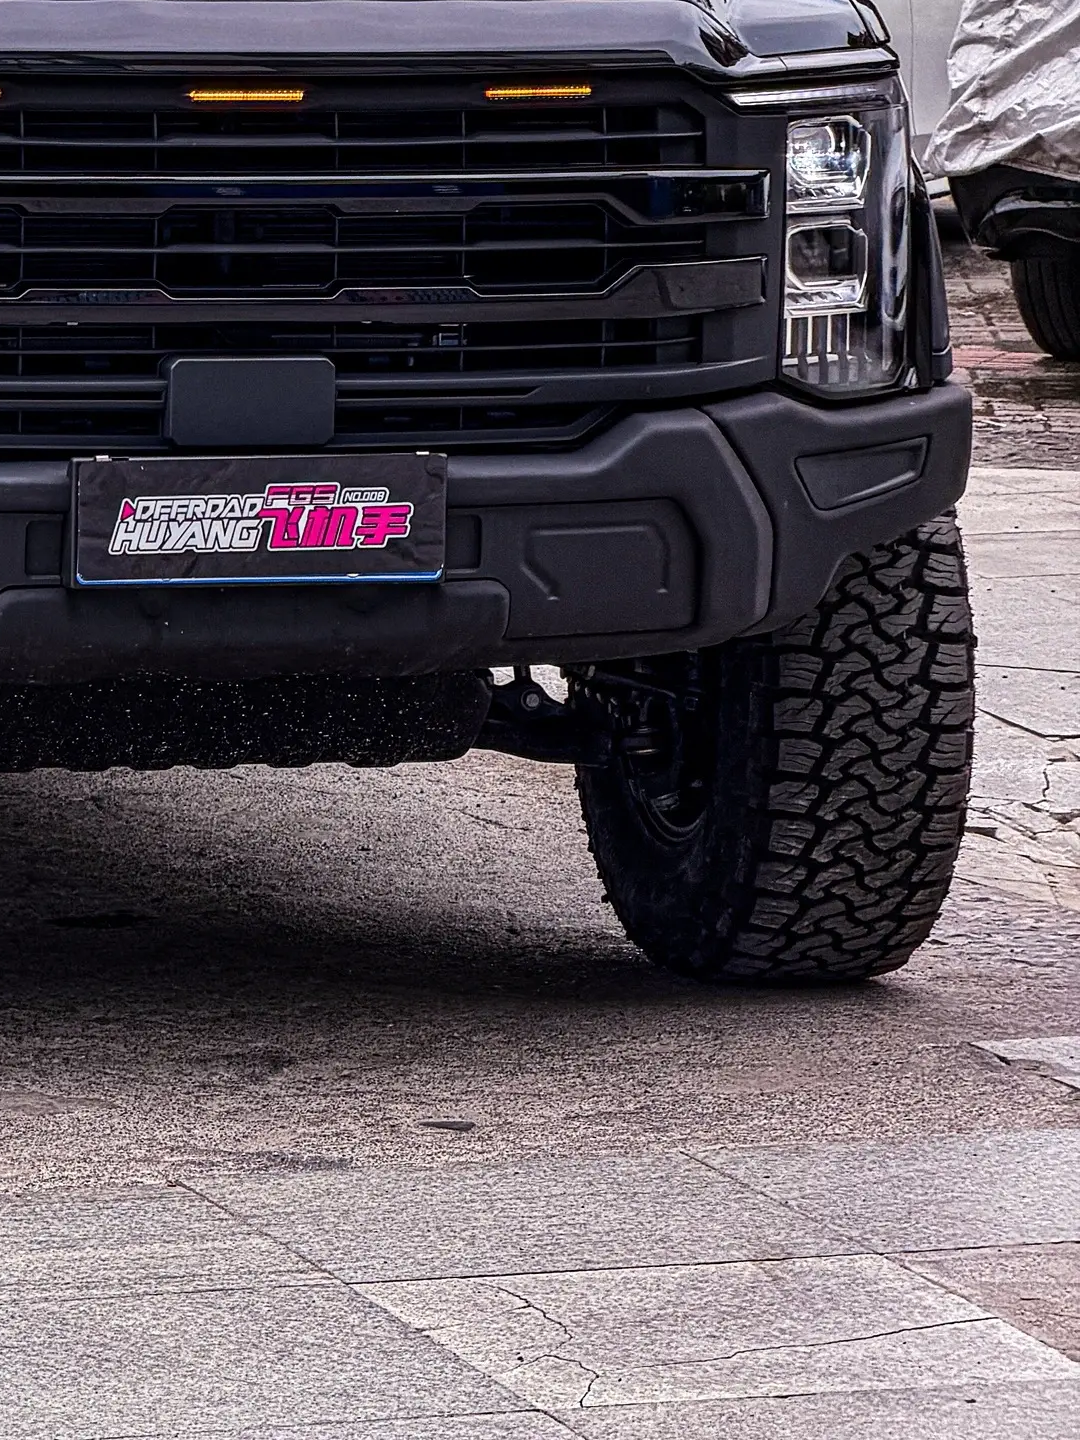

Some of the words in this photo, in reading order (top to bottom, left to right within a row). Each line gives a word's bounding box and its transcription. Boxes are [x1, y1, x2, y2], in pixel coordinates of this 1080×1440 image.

[266, 484, 338, 506] FGS
[112, 519, 262, 551] HUYANG
[257, 506, 412, 548] 飞机手
